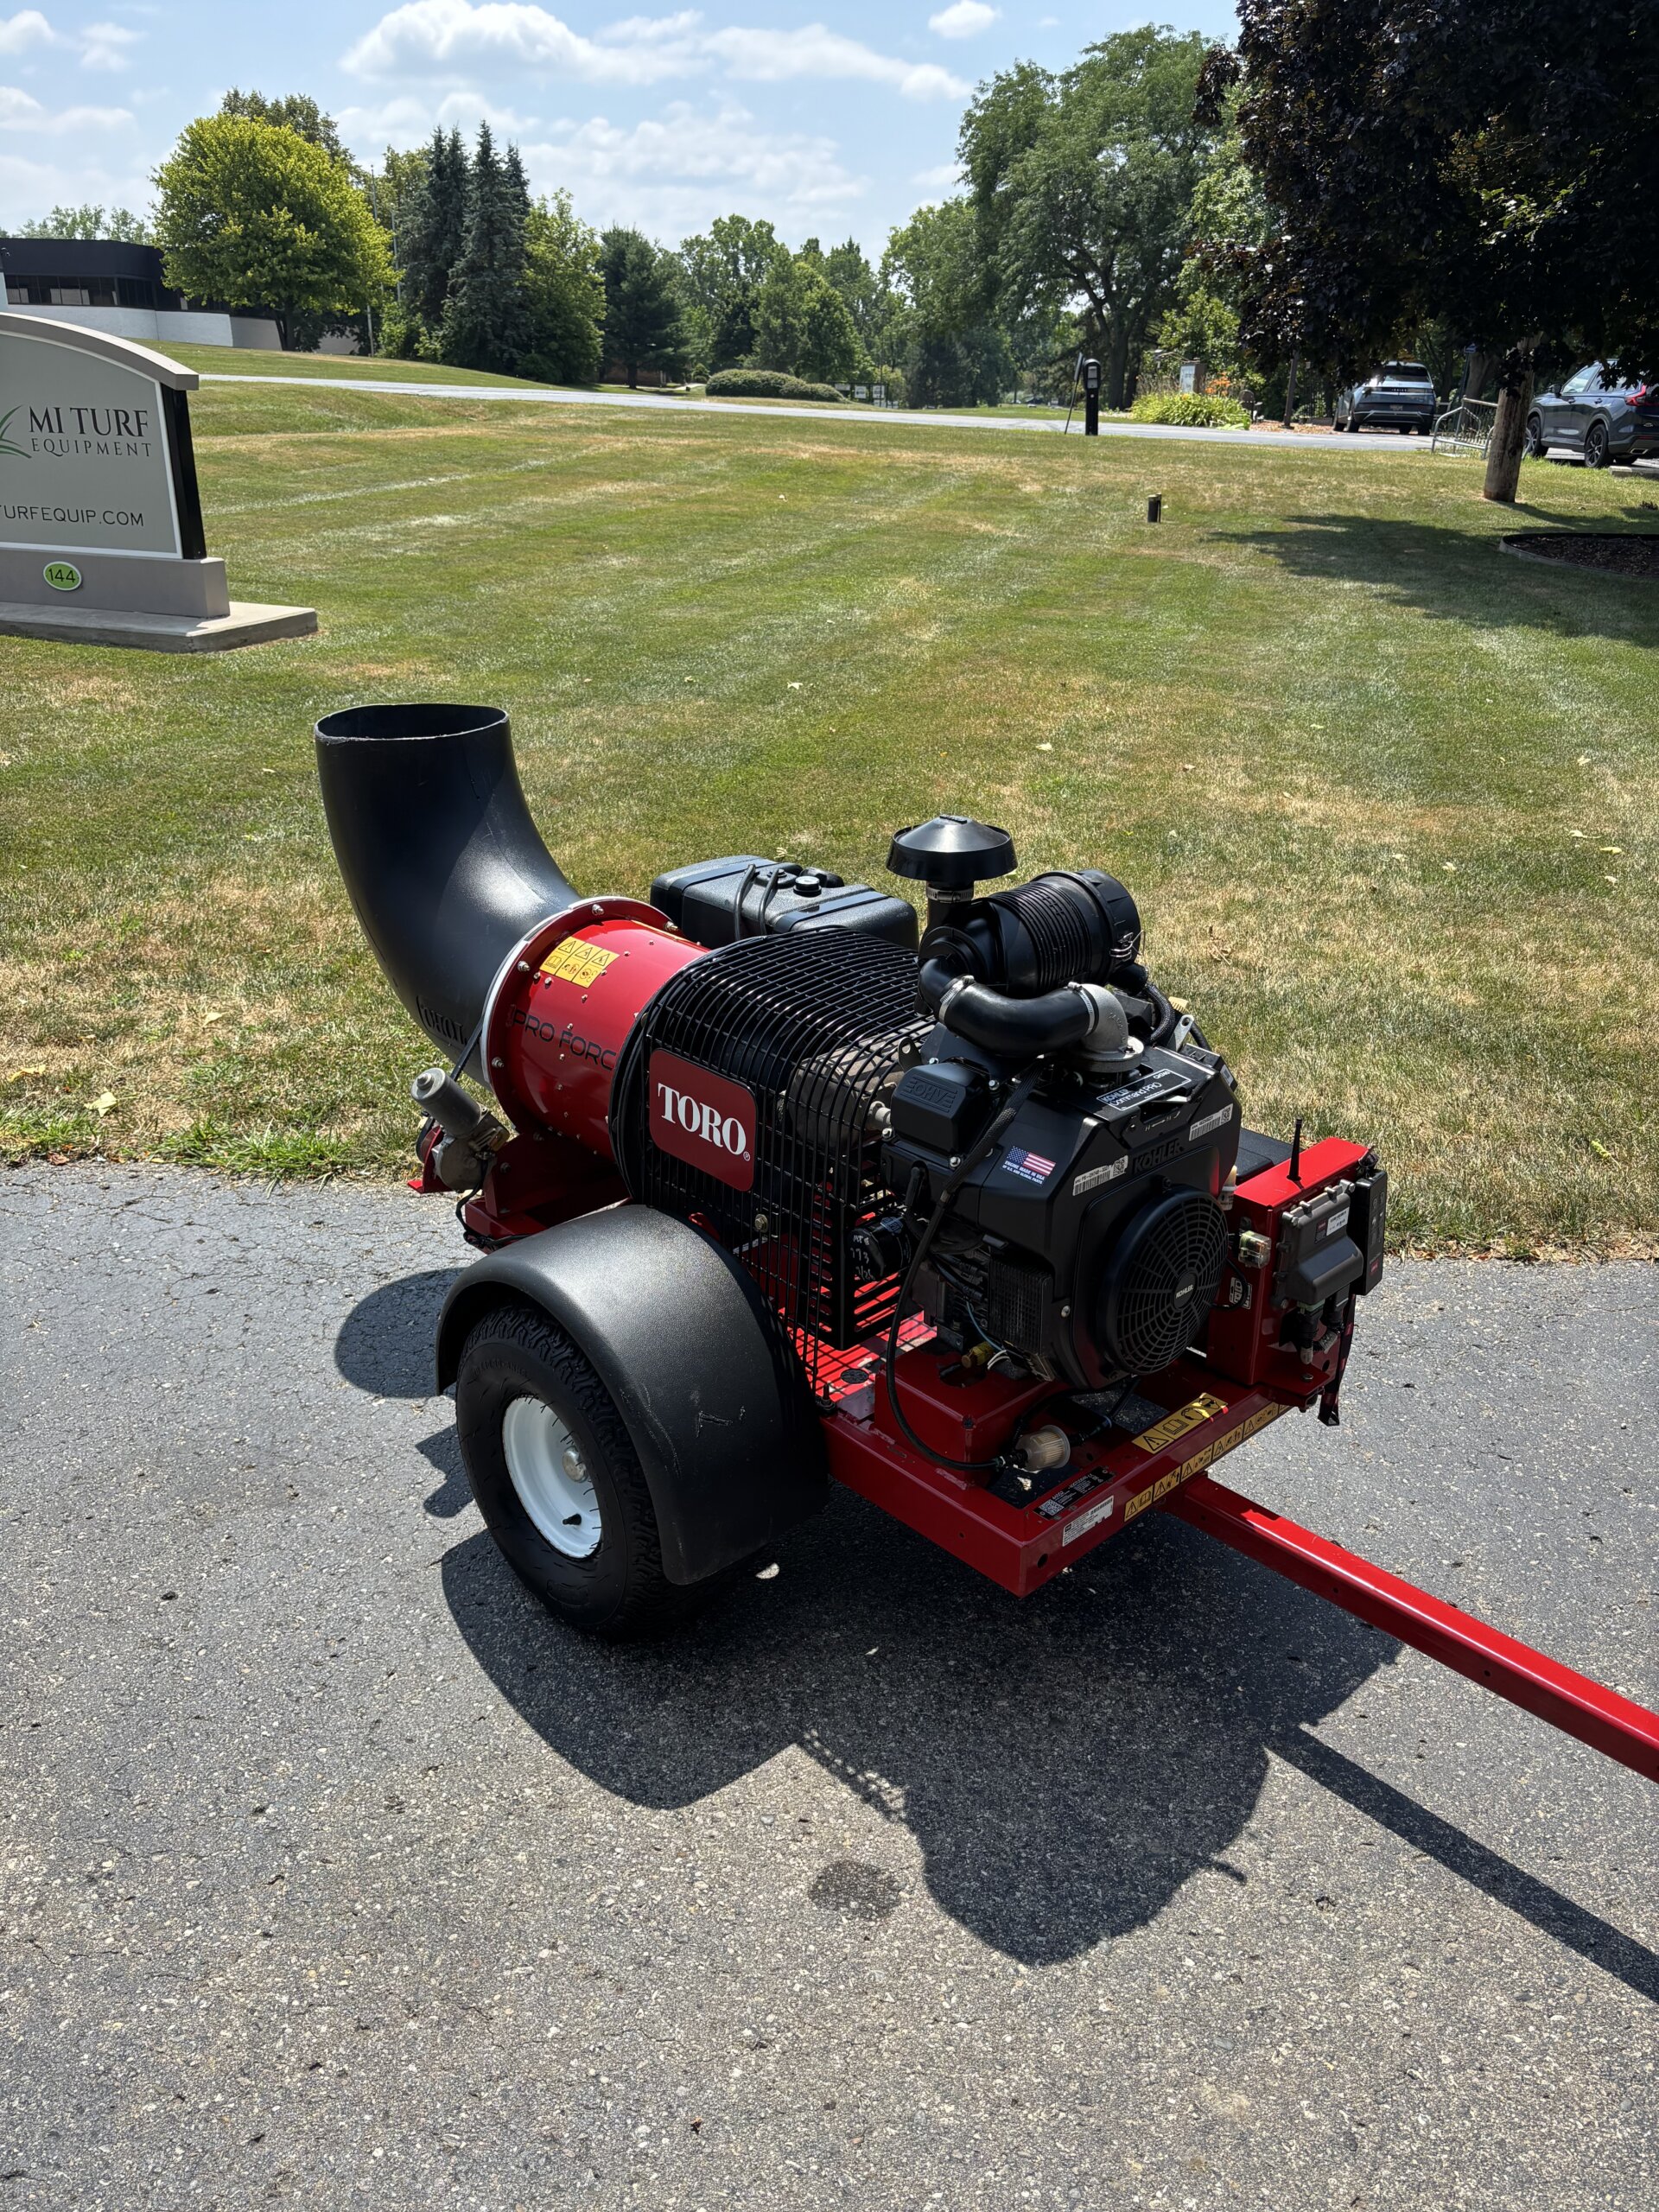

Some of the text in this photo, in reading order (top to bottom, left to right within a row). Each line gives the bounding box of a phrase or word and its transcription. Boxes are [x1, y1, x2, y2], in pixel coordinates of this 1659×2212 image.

[29, 406, 149, 437] MI TURF
[31, 437, 151, 458] EQUIPMENT
[0, 505, 144, 527] URFEQUIP.COM
[48, 568, 77, 584] 144
[512, 1008, 617, 1071] PRO FORC
[1109, 1087, 1147, 1106] Command
[1145, 1082, 1162, 1092] PRO
